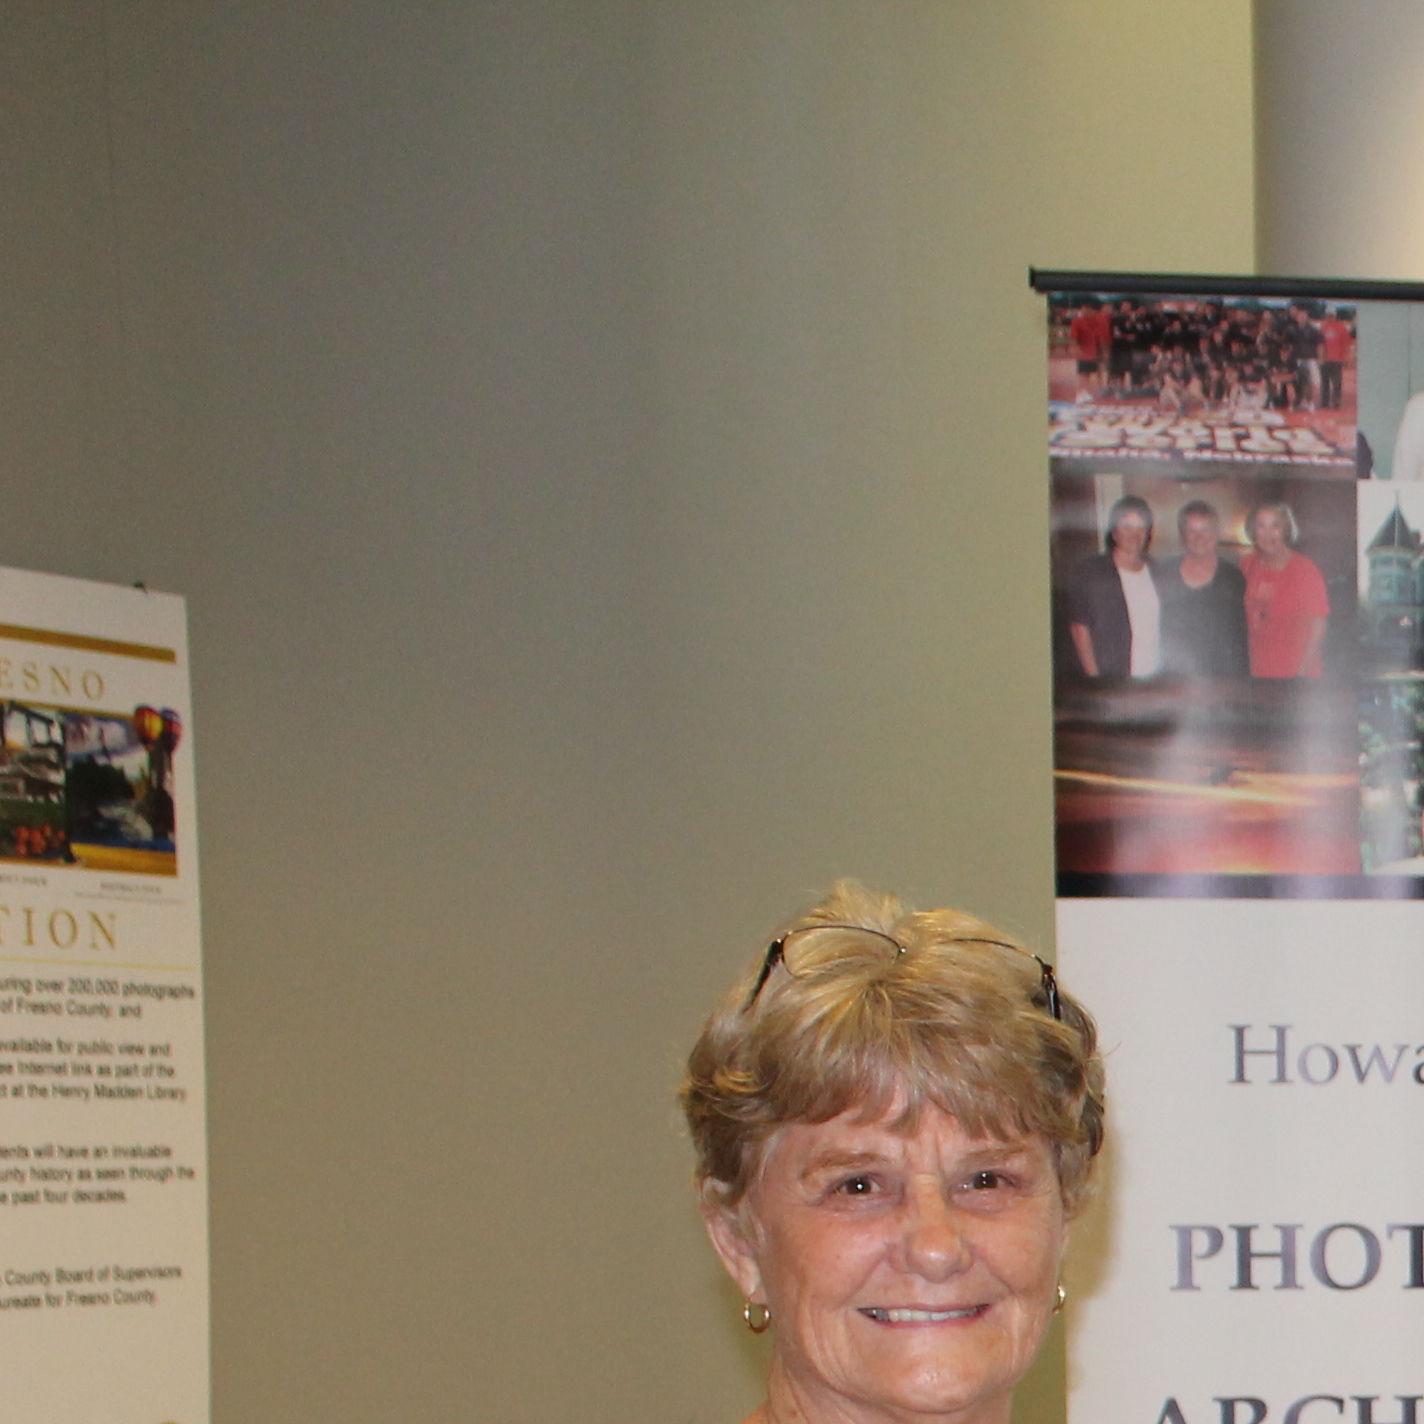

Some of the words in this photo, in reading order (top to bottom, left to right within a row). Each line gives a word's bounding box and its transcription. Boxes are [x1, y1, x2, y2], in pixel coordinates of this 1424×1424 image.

[35, 979, 65, 994] over
[118, 1004, 143, 1019] and
[148, 1042, 171, 1057] and
